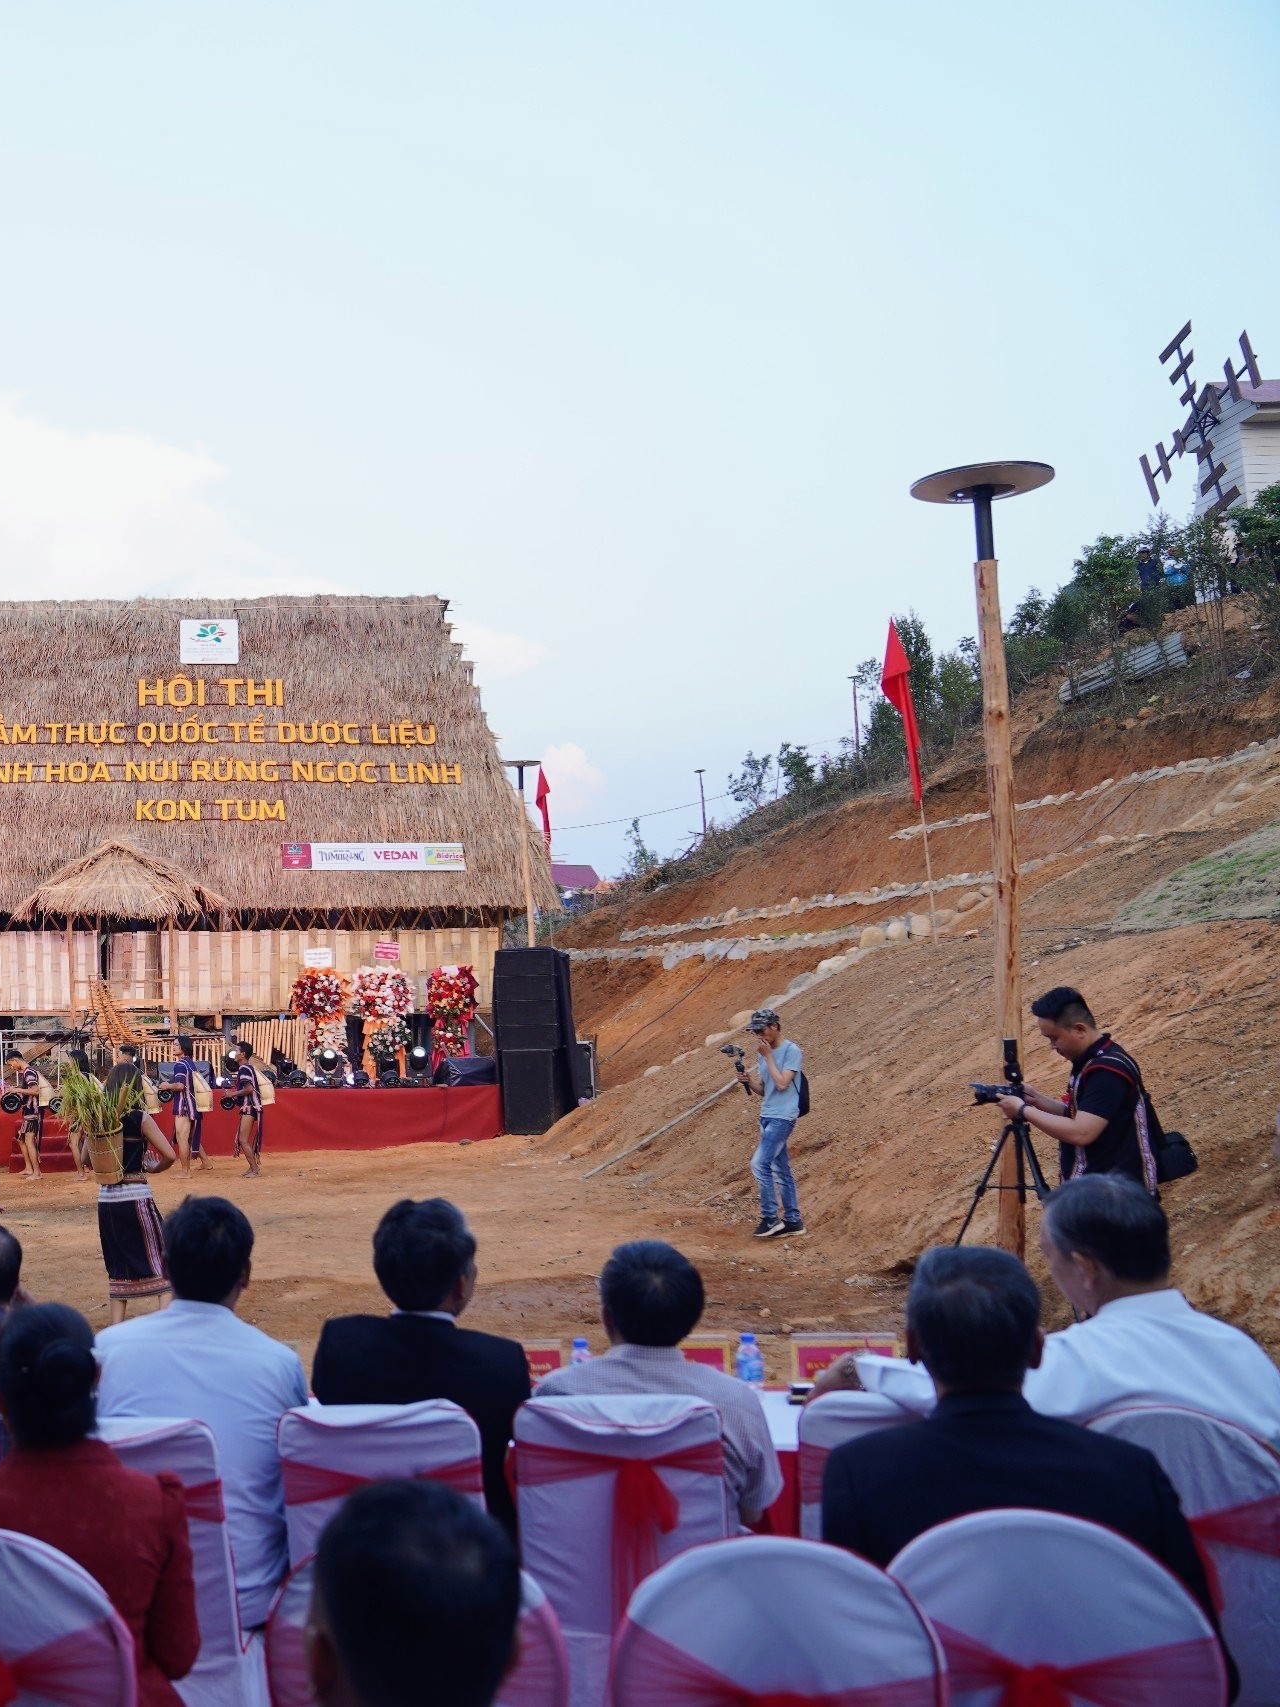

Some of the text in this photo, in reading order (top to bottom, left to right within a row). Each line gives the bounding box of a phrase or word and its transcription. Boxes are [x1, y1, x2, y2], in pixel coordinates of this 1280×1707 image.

[138, 674, 284, 713] HỘI THI
[45, 719, 126, 748] THỰC
[137, 714, 219, 747] QUỐC
[228, 713, 265, 744] TẾ
[277, 719, 361, 748] DƯỢC
[371, 719, 437, 749] LIỆU
[46, 761, 112, 783] HOA
[125, 757, 179, 783] NÚI
[192, 756, 279, 782] RỪNG
[292, 760, 378, 789] NGỌC
[389, 762, 462, 784] LINH
[136, 799, 286, 822] KON TUM
[373, 850, 419, 861] VEDAN
